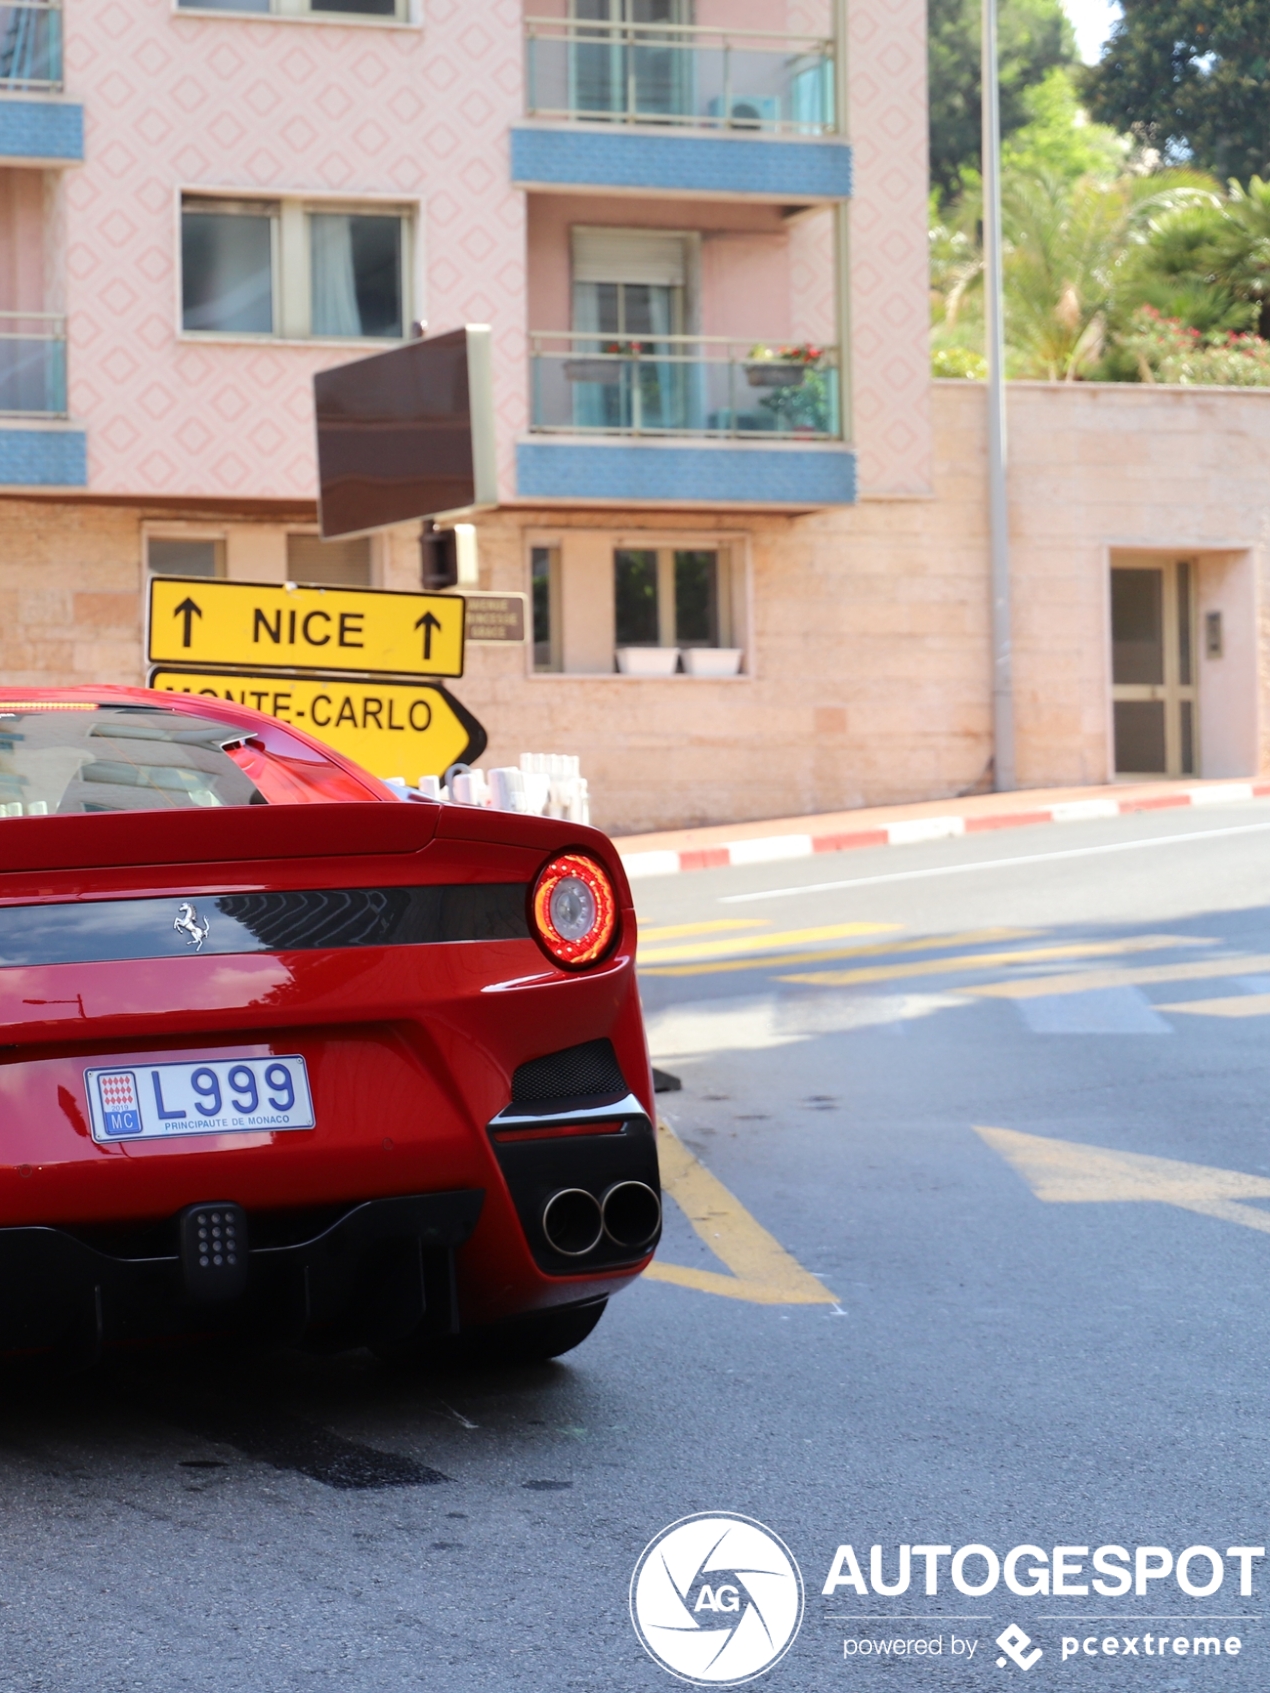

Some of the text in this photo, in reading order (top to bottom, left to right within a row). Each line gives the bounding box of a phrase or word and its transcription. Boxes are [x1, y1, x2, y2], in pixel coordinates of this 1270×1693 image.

[253, 608, 364, 648] NICE
[165, 686, 433, 732] TE-CARLO
[151, 1063, 296, 1120] L999
[111, 1112, 134, 1130] MC
[164, 1114, 290, 1131] PRINCIPAUTE DE MONACO
